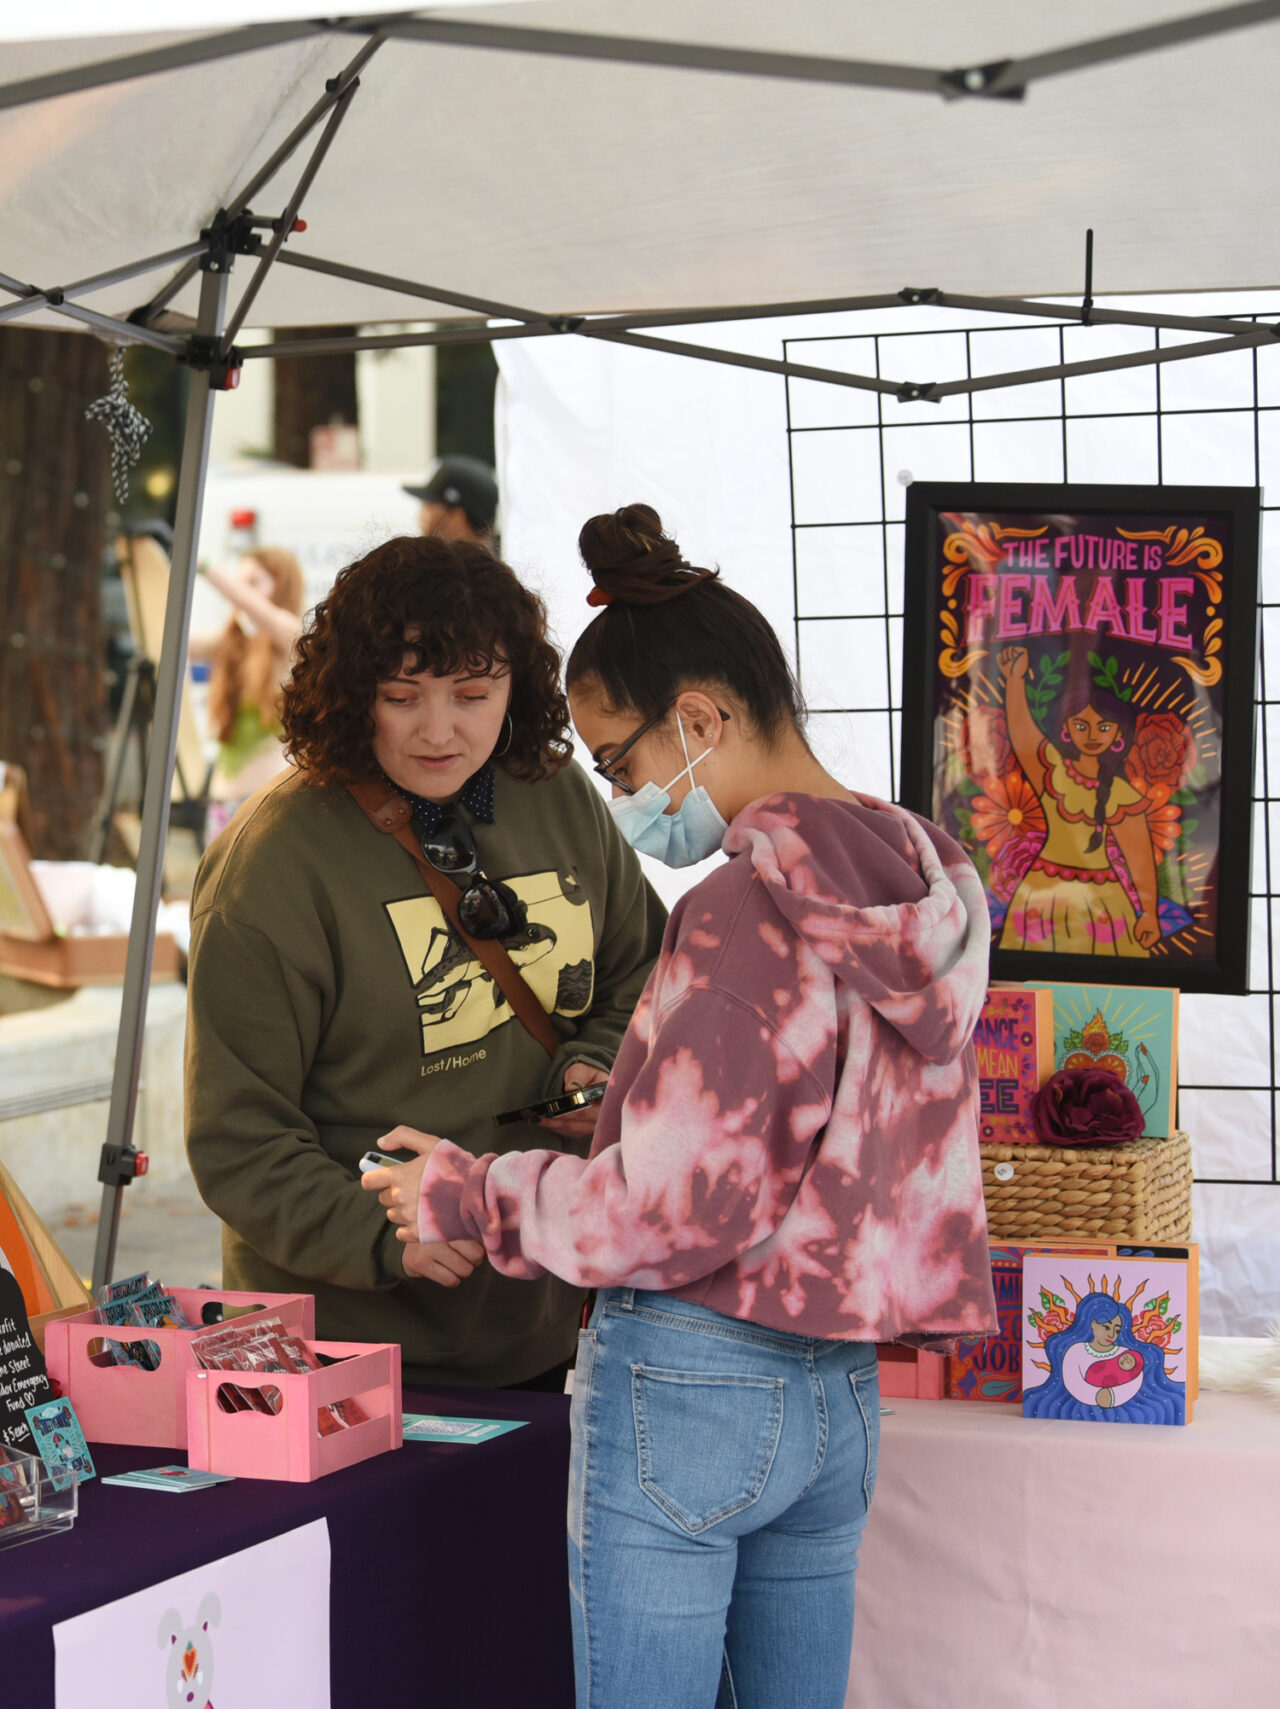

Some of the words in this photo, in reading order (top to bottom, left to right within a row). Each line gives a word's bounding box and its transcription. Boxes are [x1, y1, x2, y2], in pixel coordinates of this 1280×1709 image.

[1002, 538, 1050, 569] THE
[1054, 534, 1138, 570] FUTURE
[1144, 545, 1162, 570] IS
[963, 573, 1194, 652] FEMALE
[421, 1049, 487, 1077] Lost/Home
[3, 1332, 32, 1353] donated
[10, 1355, 31, 1373] Street
[12, 1373, 49, 1393] Emergency
[6, 1398, 26, 1412] Fund
[14, 1422, 30, 1437] each
